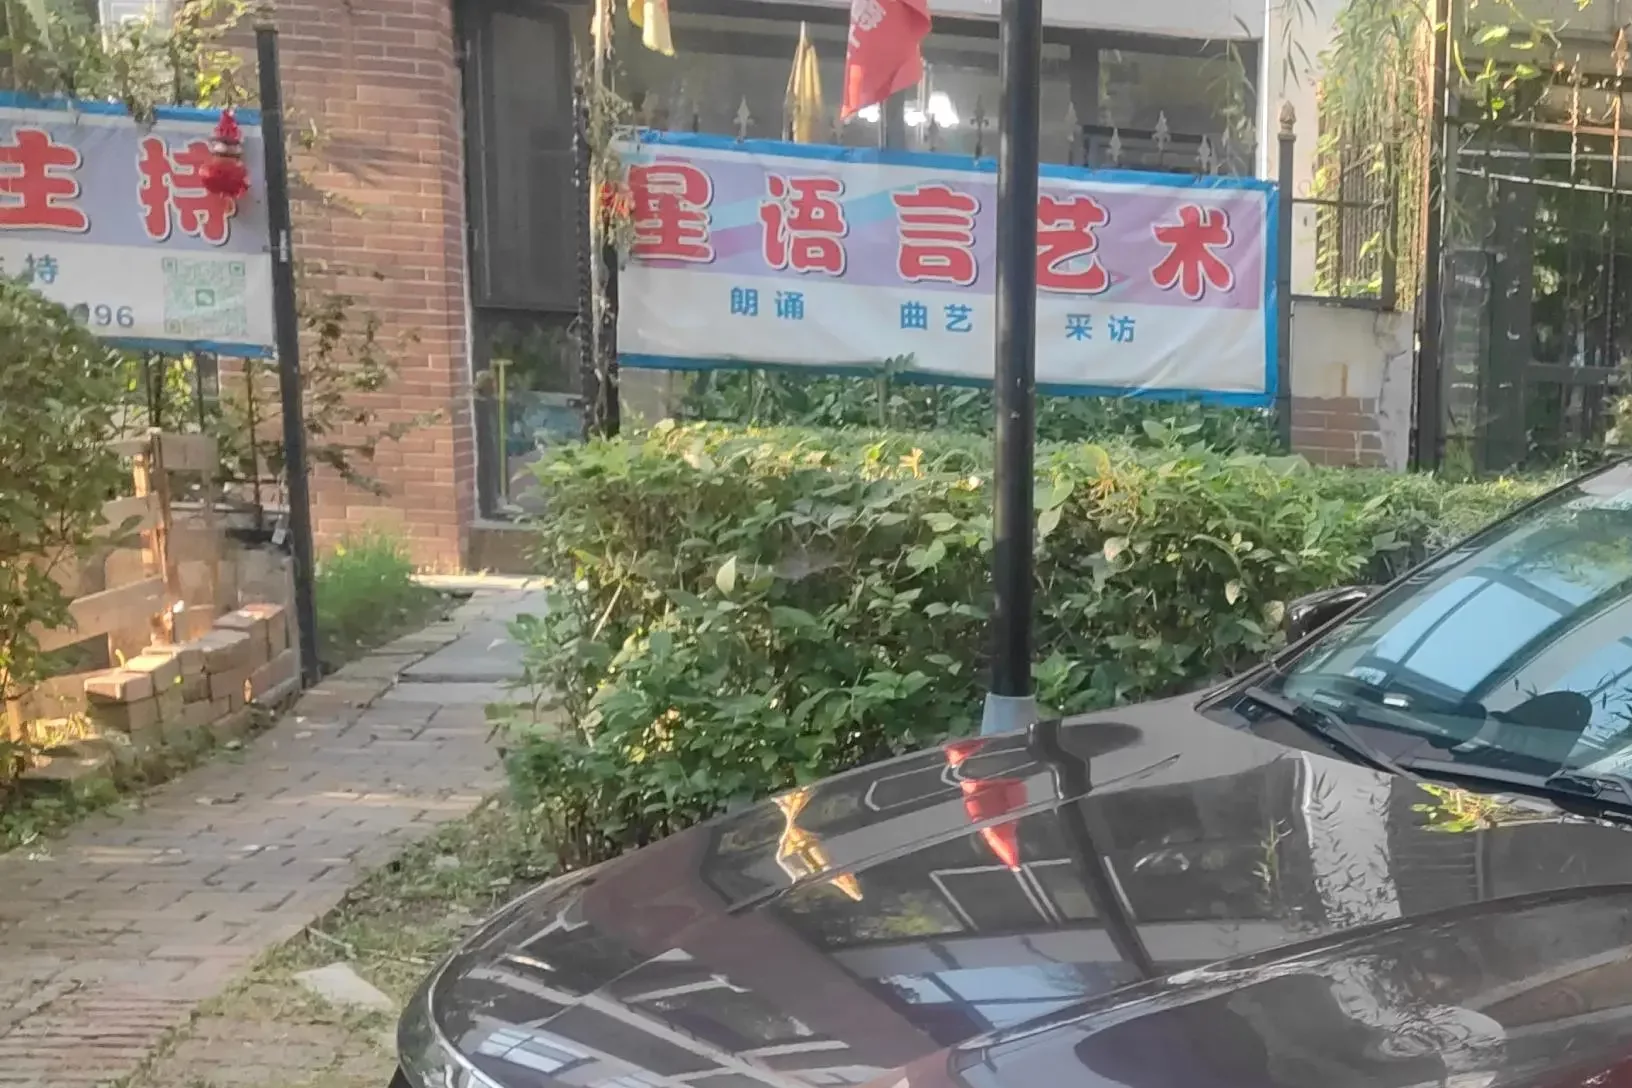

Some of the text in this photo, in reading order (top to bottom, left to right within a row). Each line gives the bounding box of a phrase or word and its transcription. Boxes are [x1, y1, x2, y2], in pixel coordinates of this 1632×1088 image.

[0, 129, 234, 245] 主持
[628, 163, 1234, 300] 星语言艺术
[71, 302, 135, 328] 96
[730, 286, 1136, 343] 朗诵 曲艺 采访
